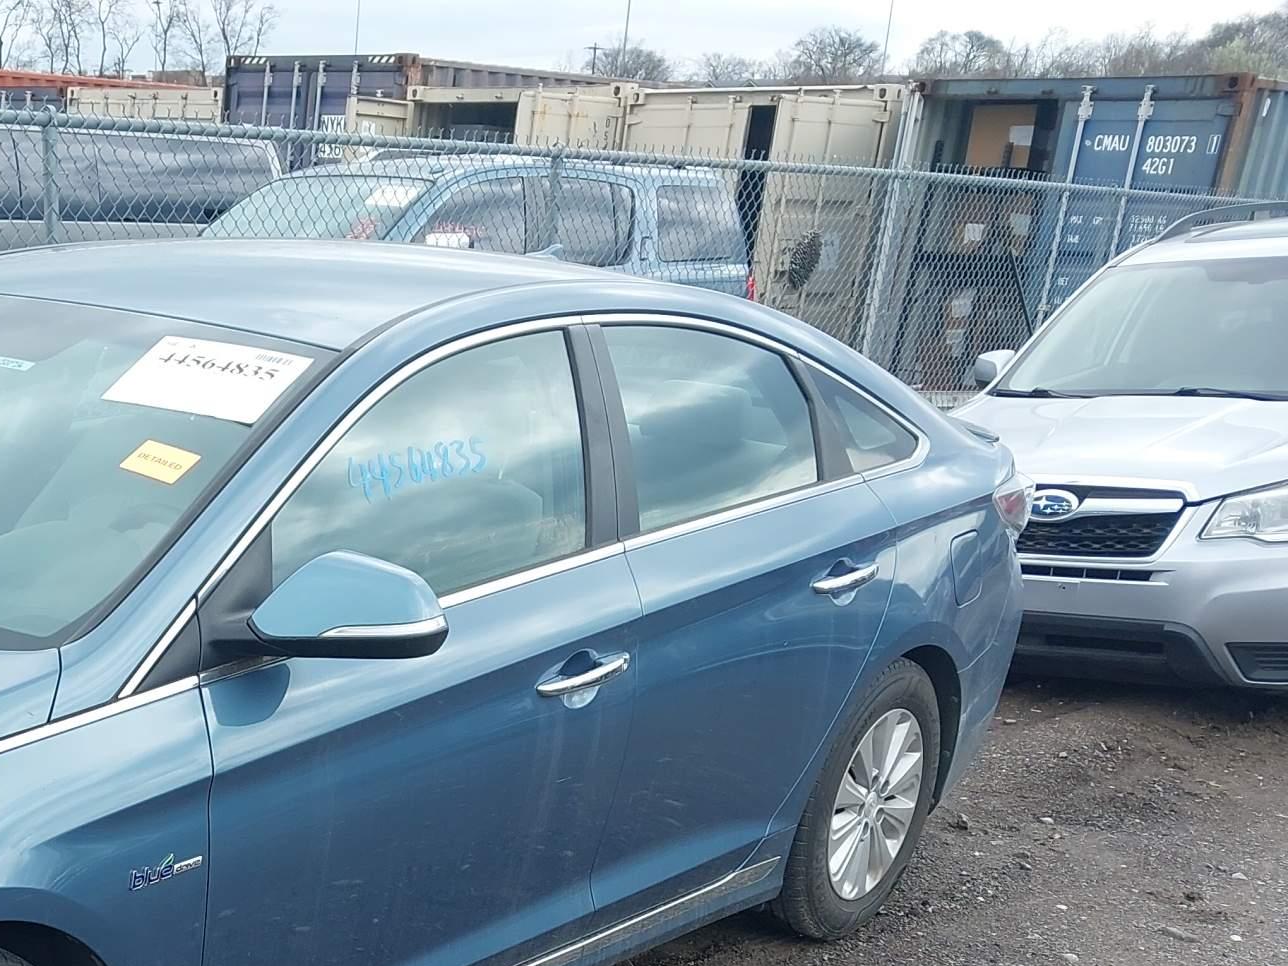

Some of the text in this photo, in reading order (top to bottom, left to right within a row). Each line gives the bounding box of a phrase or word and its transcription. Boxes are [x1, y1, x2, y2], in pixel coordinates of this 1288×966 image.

[1094, 135, 1130, 151] CMAU
[1146, 135, 1198, 153] 803073
[1142, 157, 1175, 175] 42G1
[159, 352, 280, 381] 44564835
[347, 436, 488, 504] 44564835
[129, 866, 174, 890] blue
